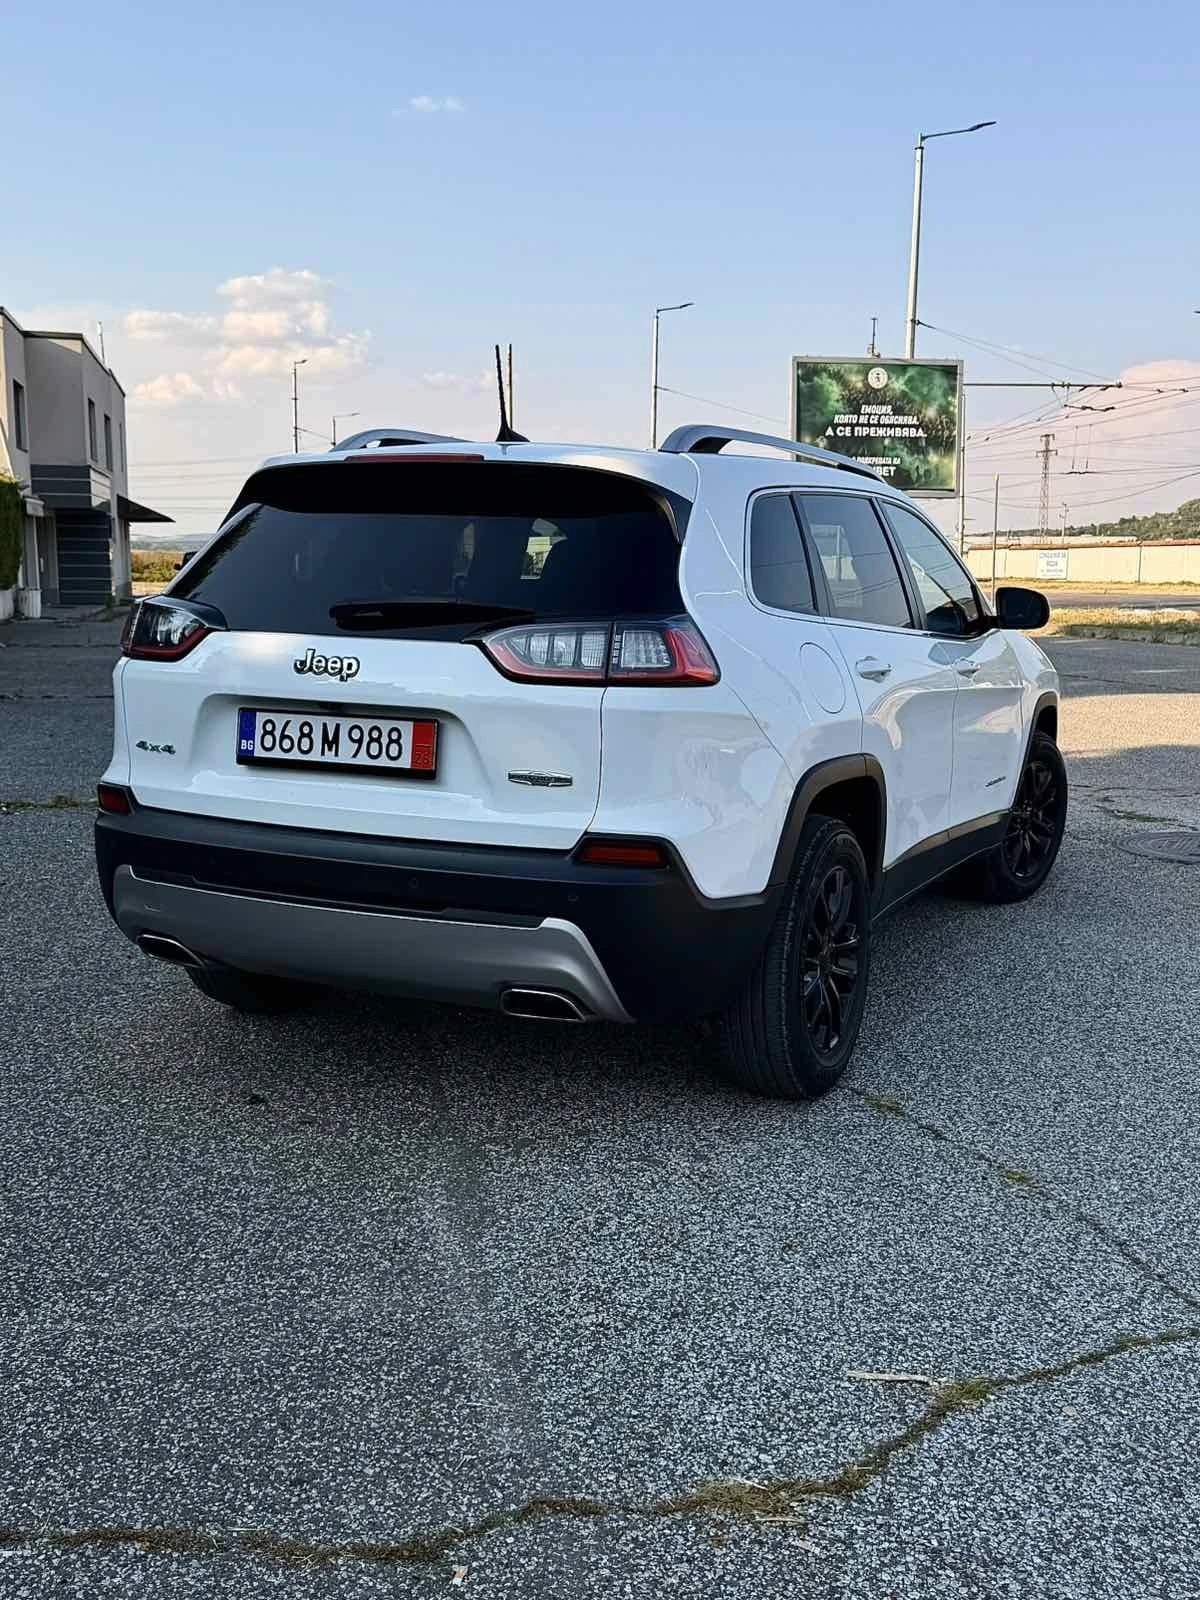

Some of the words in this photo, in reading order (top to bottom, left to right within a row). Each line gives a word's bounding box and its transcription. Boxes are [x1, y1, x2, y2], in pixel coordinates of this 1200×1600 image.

[860, 404, 893, 415] ЕМОЦИЯ,
[833, 414, 858, 424] КОЯТО
[859, 415, 868, 424] НЕ
[869, 415, 879, 424] СЕ
[825, 426, 834, 436] А
[836, 426, 852, 437] СЕ
[854, 426, 928, 437] ПРЕЖИВЯВА.
[294, 648, 360, 682] Jeep
[240, 739, 254, 750] BG
[260, 718, 314, 755] 868
[320, 721, 341, 757] M
[348, 724, 403, 761] 988
